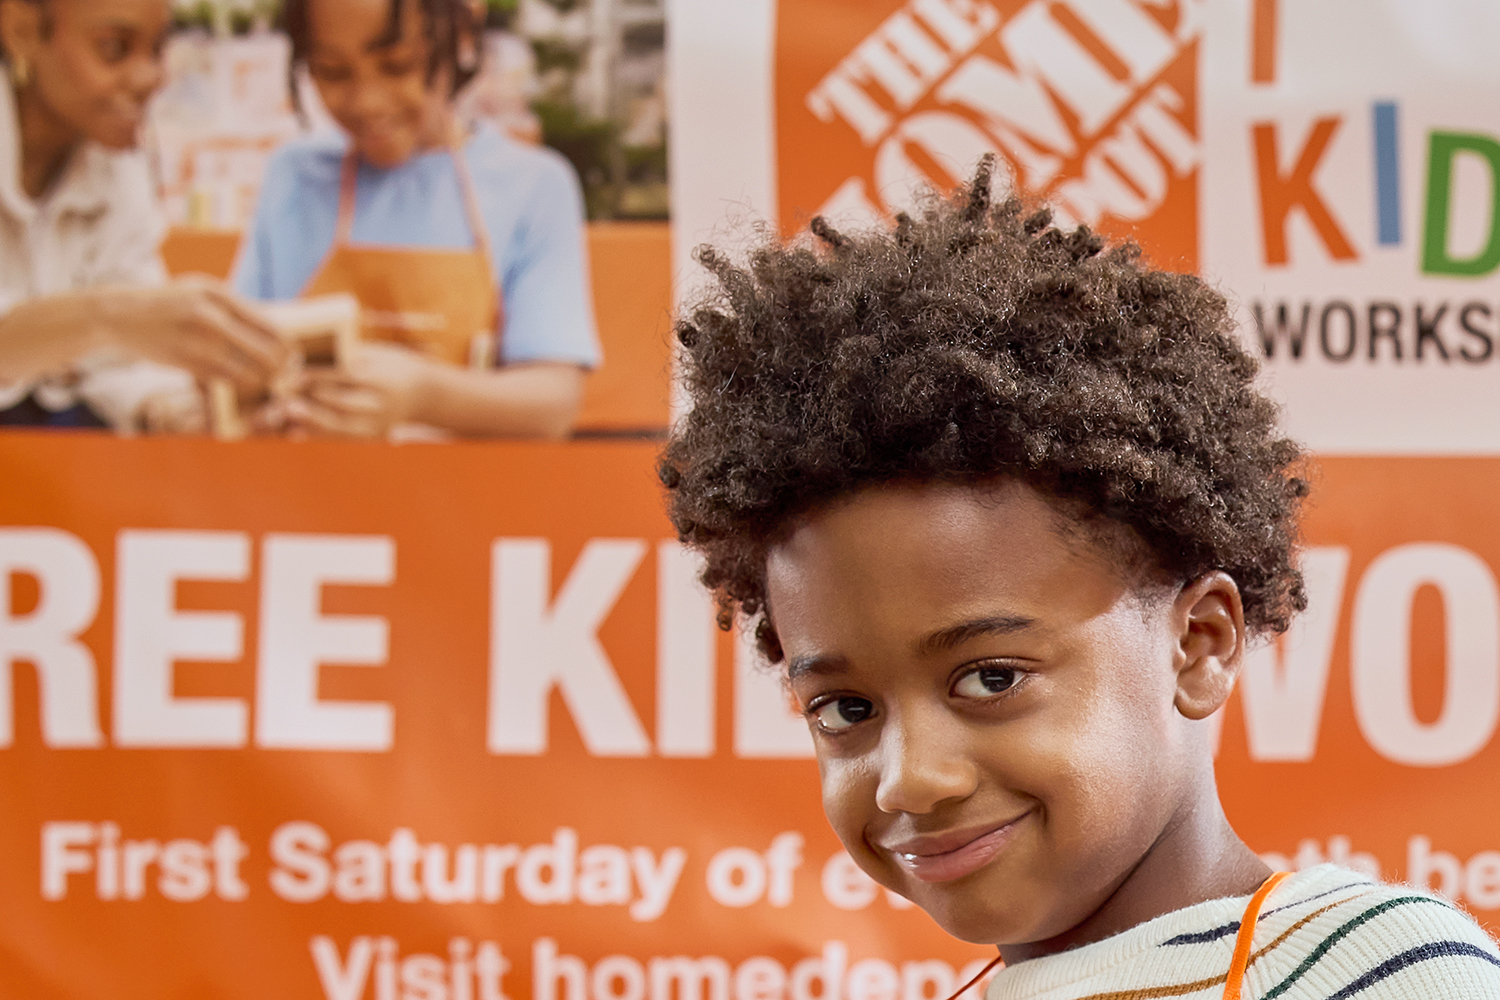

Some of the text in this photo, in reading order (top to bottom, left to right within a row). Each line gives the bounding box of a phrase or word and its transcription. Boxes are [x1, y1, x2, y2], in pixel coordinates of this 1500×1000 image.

[803, 0, 998, 146] THE
[40, 821, 250, 901] First
[268, 822, 687, 921] Saturday
[705, 831, 805, 909] of
